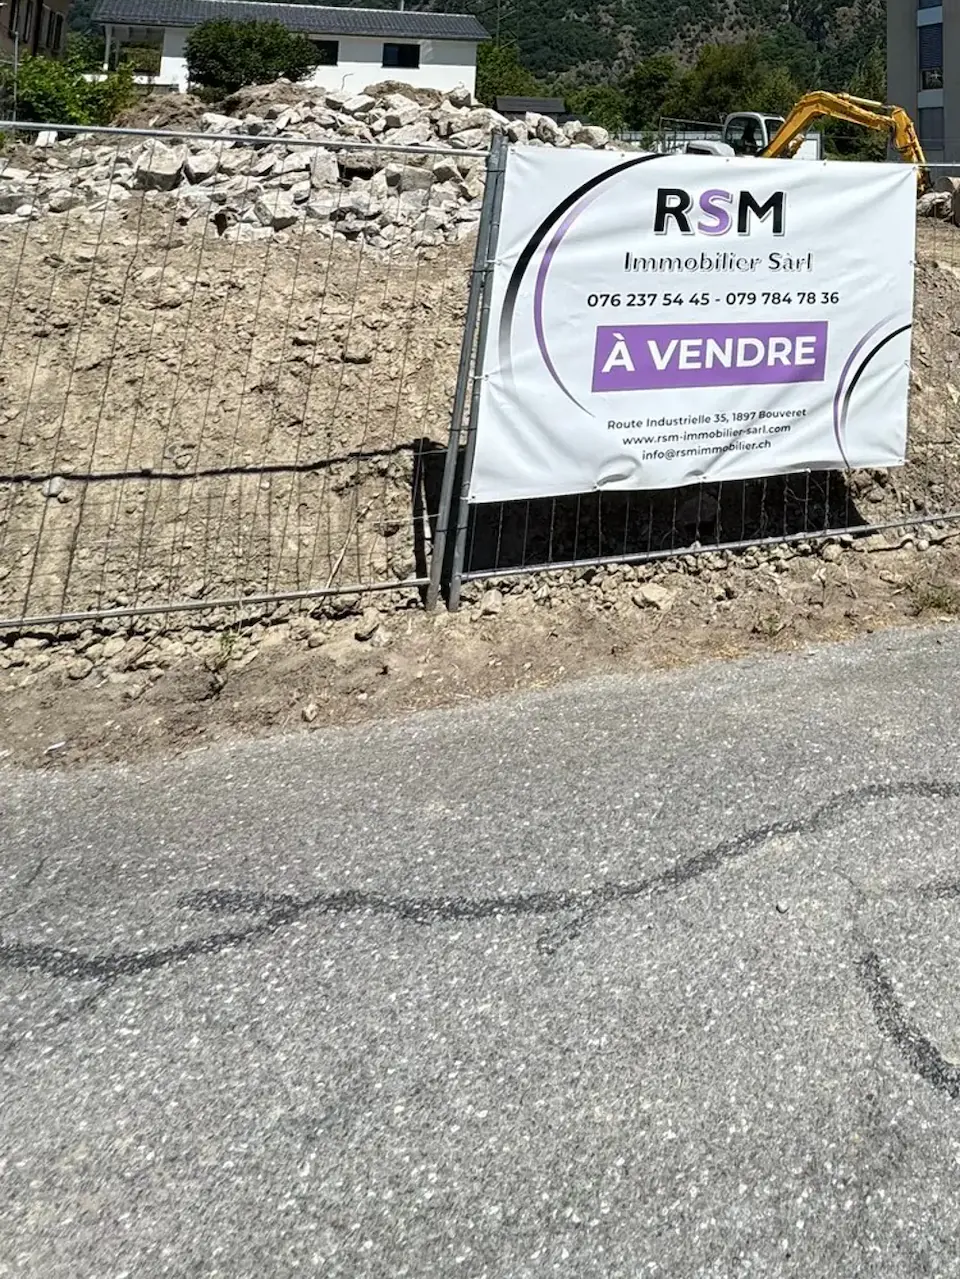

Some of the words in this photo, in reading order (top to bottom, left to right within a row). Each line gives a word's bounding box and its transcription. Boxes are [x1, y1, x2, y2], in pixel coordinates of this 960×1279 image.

[654, 188, 787, 236] RSM
[624, 252, 761, 272] Immobilier
[587, 293, 621, 308] 076
[626, 293, 657, 307] 237
[662, 293, 684, 306] 54
[688, 292, 710, 306] 45
[726, 292, 757, 305] 079
[761, 292, 793, 305] 784
[797, 291, 816, 305] 78
[820, 291, 840, 305] 36
[601, 332, 635, 373] À
[647, 335, 817, 371] VENDRE
[607, 419, 643, 430] Route
[646, 414, 711, 427] Industrielle
[732, 411, 756, 422] 1897
[759, 409, 806, 419] Bouveret
[622, 424, 791, 446] www.rsm-immobilier-sarl.com
[642, 440, 771, 461] info@rsmimmobilier.ch
